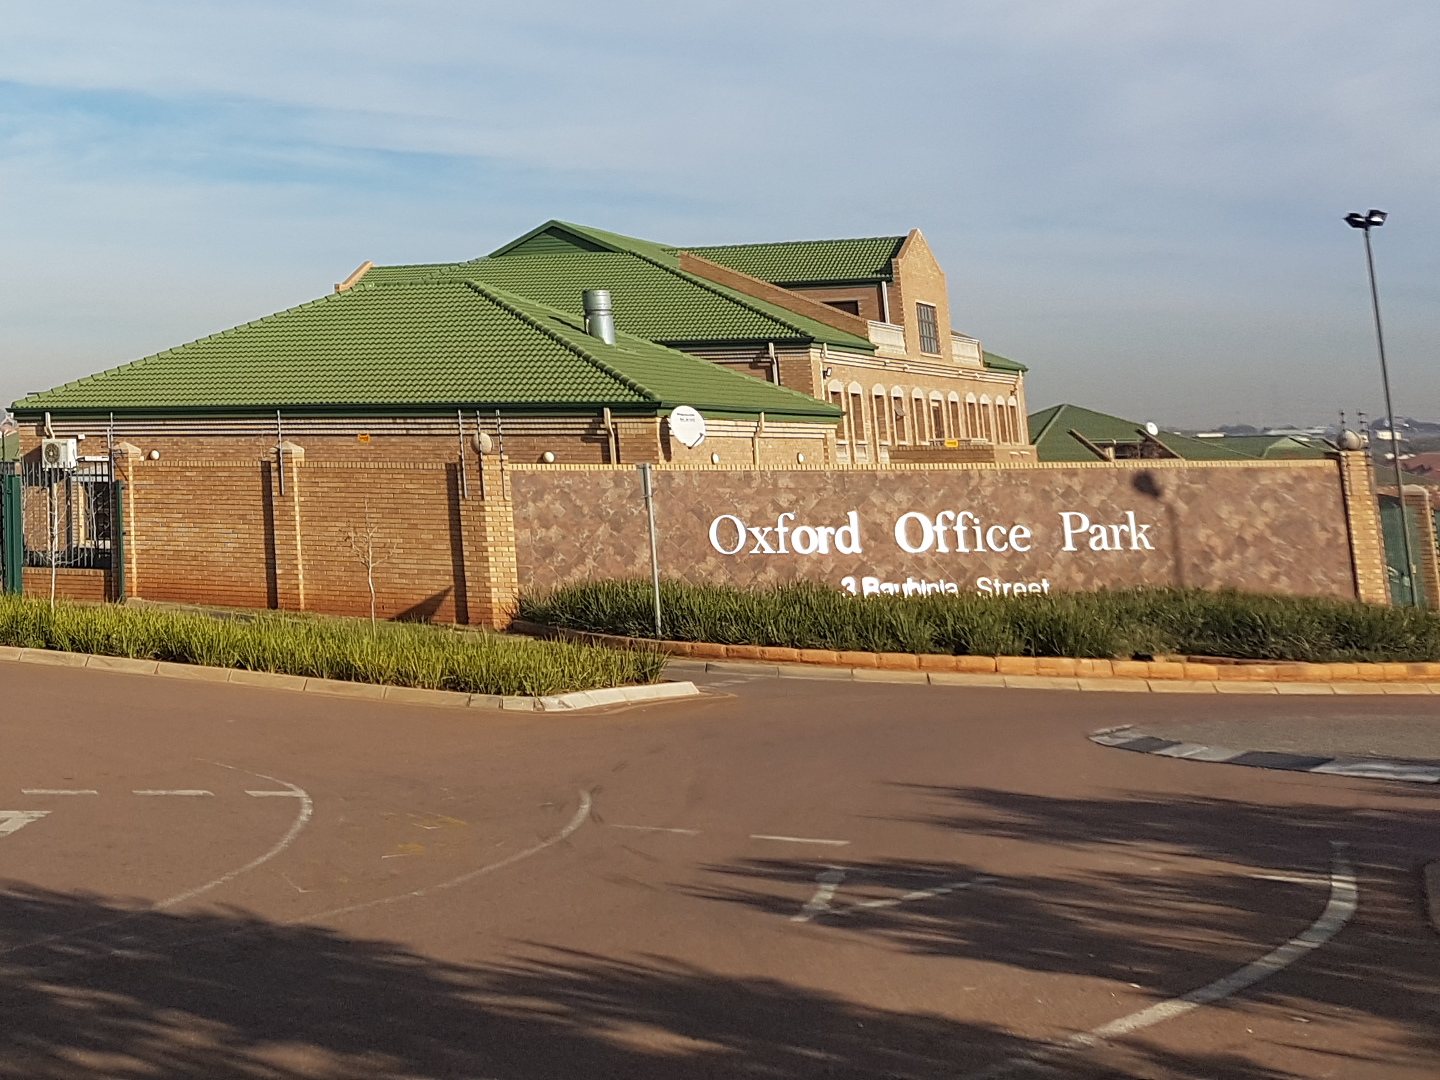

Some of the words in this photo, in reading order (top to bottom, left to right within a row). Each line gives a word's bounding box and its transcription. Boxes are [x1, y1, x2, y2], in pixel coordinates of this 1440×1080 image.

[708, 511, 861, 554] Oxford
[894, 511, 1032, 553] Office
[1059, 511, 1155, 552] Park
[841, 576, 857, 598] 3
